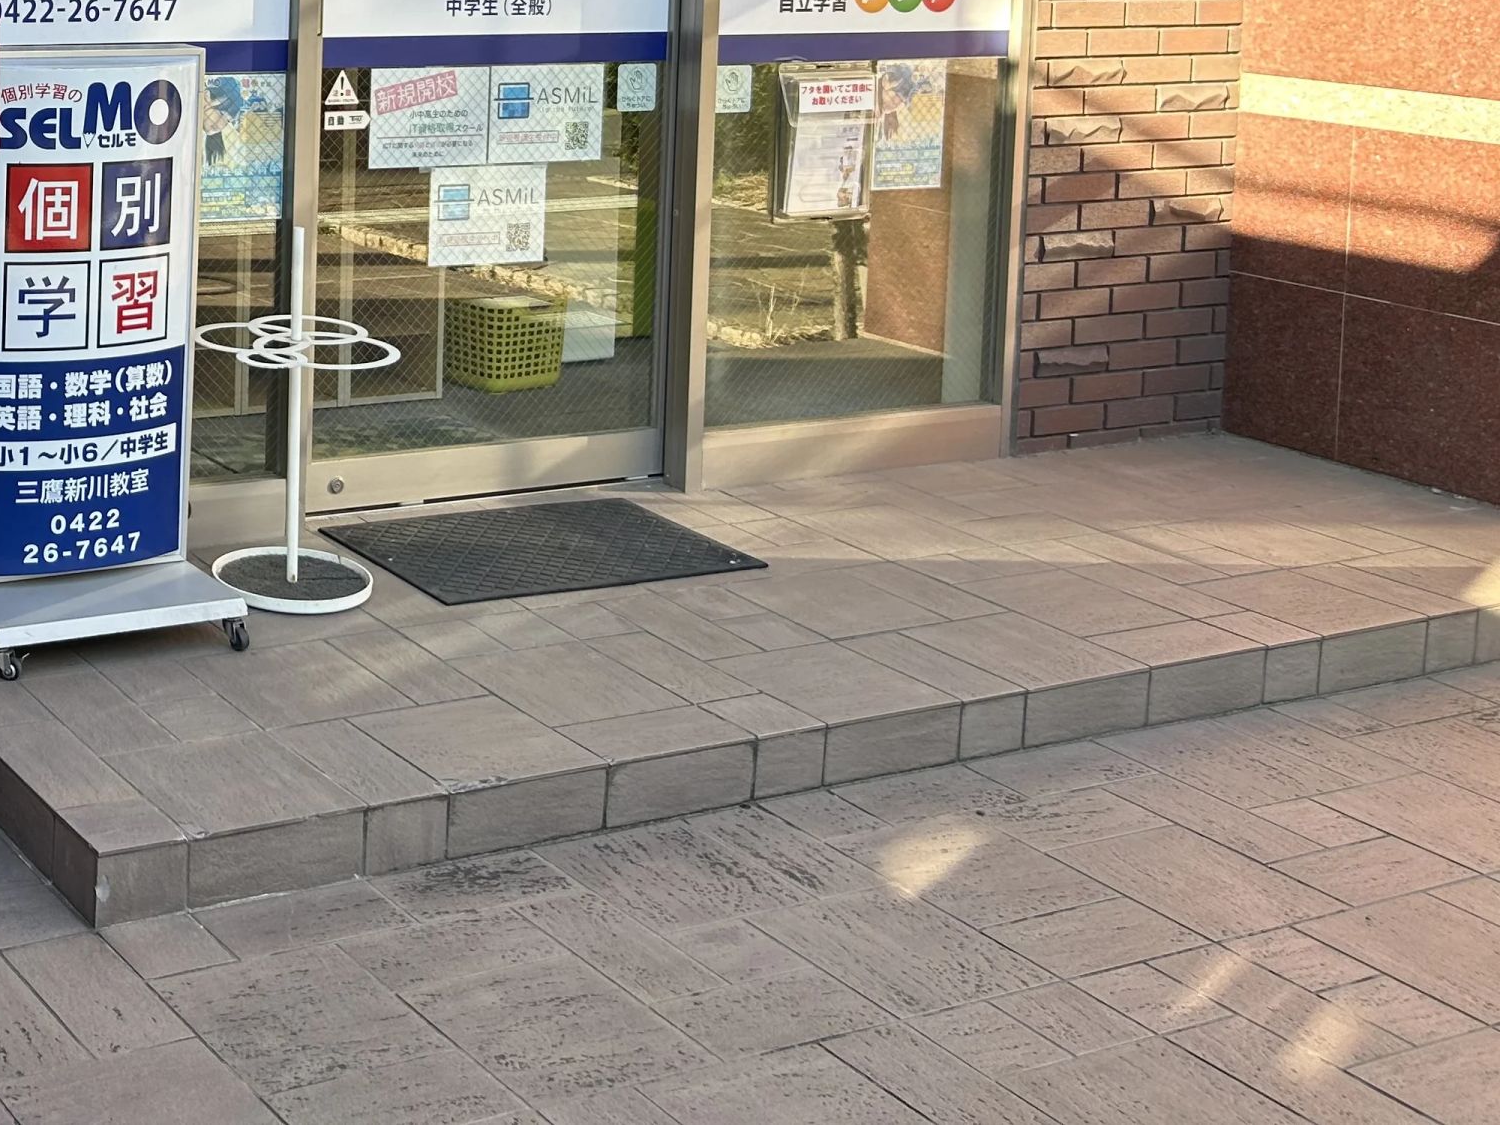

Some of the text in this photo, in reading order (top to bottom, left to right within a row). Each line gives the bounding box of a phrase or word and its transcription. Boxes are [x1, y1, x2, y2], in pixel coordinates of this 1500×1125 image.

[0, 82, 83, 104] 個別学習の
[376, 75, 456, 112] 新規開校
[537, 87, 599, 105] ASMiL
[812, 96, 862, 106] お取りください
[0, 79, 183, 150] SELMO
[97, 132, 137, 148] セルモ
[16, 171, 162, 243] 個別
[478, 188, 539, 206] ASMiL
[16, 269, 160, 339] 学習
[15, 468, 149, 504] 三鷹新川教室
[50, 508, 120, 535] 0422
[23, 531, 141, 564] 26-7647
